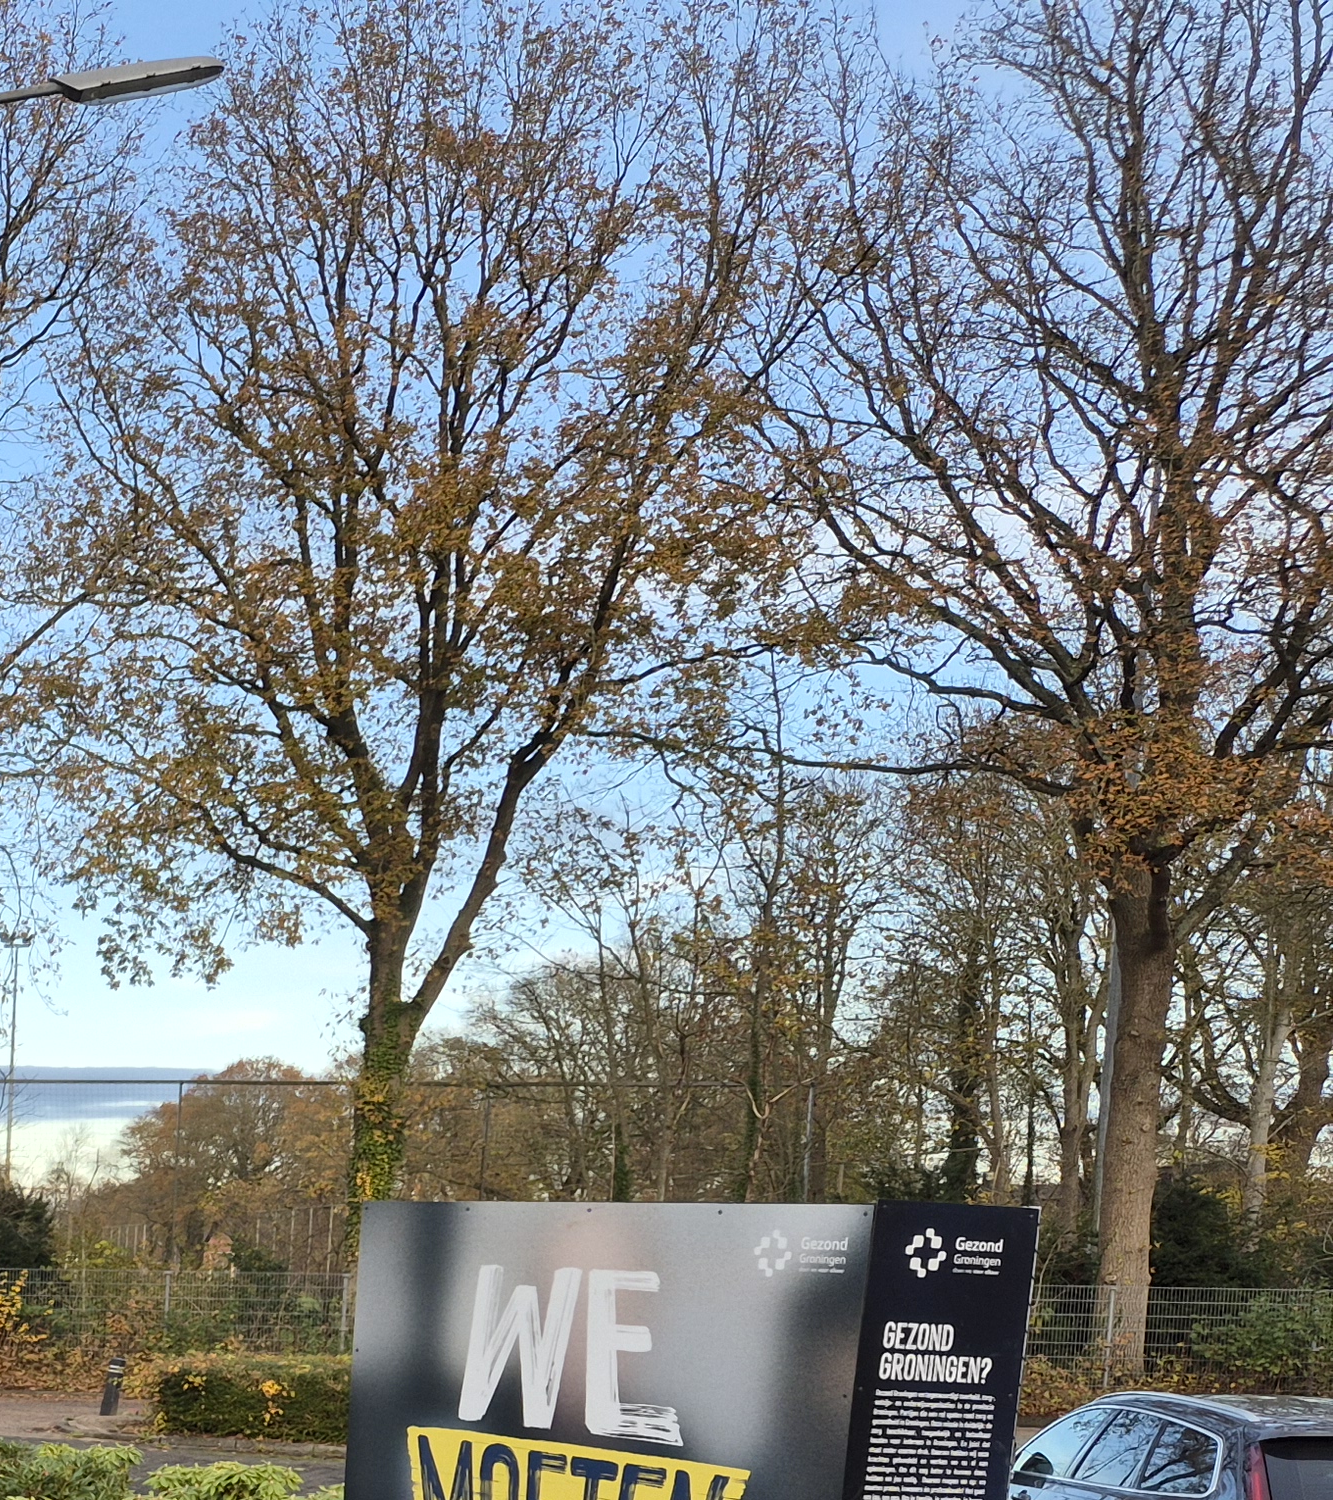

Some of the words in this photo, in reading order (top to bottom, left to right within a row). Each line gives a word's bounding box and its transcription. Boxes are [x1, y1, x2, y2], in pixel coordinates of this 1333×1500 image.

[801, 1237, 849, 1251] Gezond
[955, 1236, 1004, 1253] Gezond
[799, 1253, 847, 1267] Groningen
[953, 1254, 1001, 1268] Groningen
[883, 1321, 955, 1352] GEZOND
[458, 1265, 683, 1446] WE
[878, 1353, 993, 1384] GRONINGEN?
